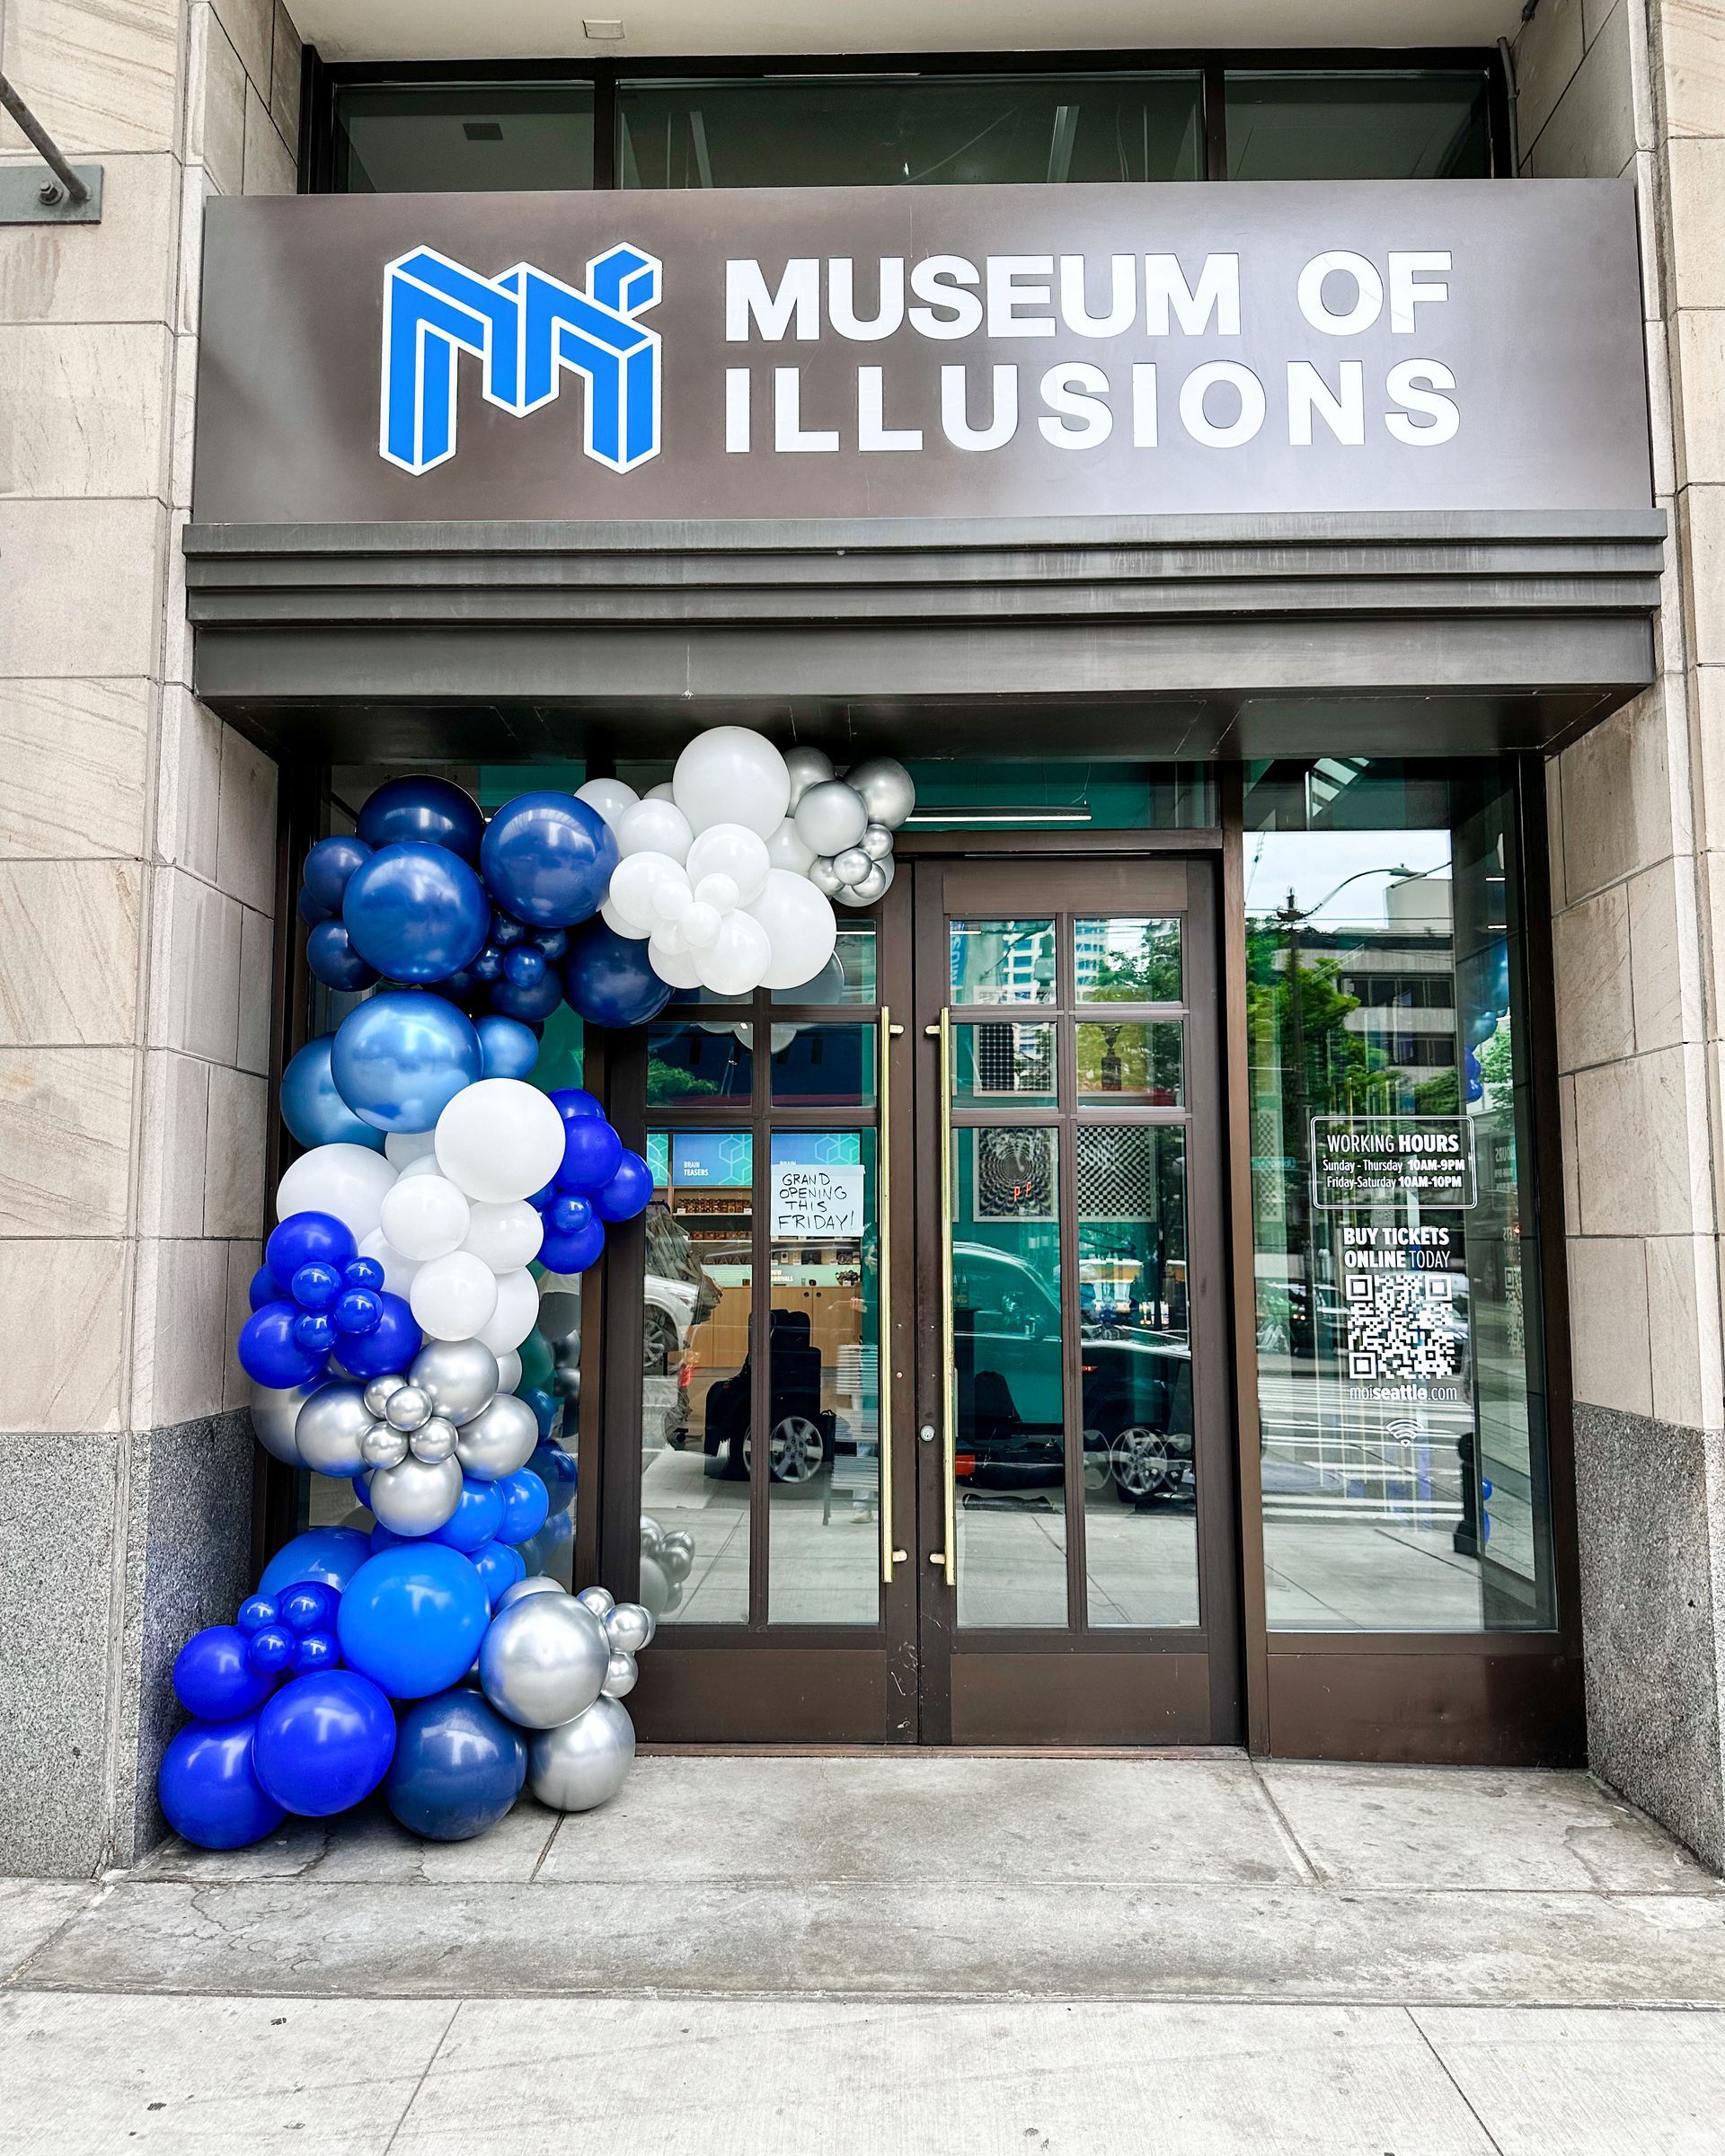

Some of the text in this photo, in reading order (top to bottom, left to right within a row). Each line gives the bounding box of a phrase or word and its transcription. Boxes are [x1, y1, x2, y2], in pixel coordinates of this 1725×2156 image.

[724, 250, 1453, 343] MUSEUM OF
[724, 358, 1461, 454] ILLUSIONS
[1326, 1134, 1459, 1153] WORKING HOURS
[1322, 1159, 1356, 1174] Sunday
[1362, 1159, 1402, 1174] Thursday
[1407, 1159, 1465, 1171] 10AM-9PM
[782, 1172, 831, 1186] GRAND
[1327, 1176, 1463, 1190] Friday-Saturday 10AM-10PM
[779, 1186, 847, 1200] OPENING
[784, 1200, 827, 1213] THIS
[778, 1210, 854, 1232] FRIDAY!
[1343, 1227, 1450, 1246] BUY TICKETS
[1344, 1250, 1450, 1268] ONLINE TODAY
[1349, 1384, 1457, 1401] moiseattle.com
